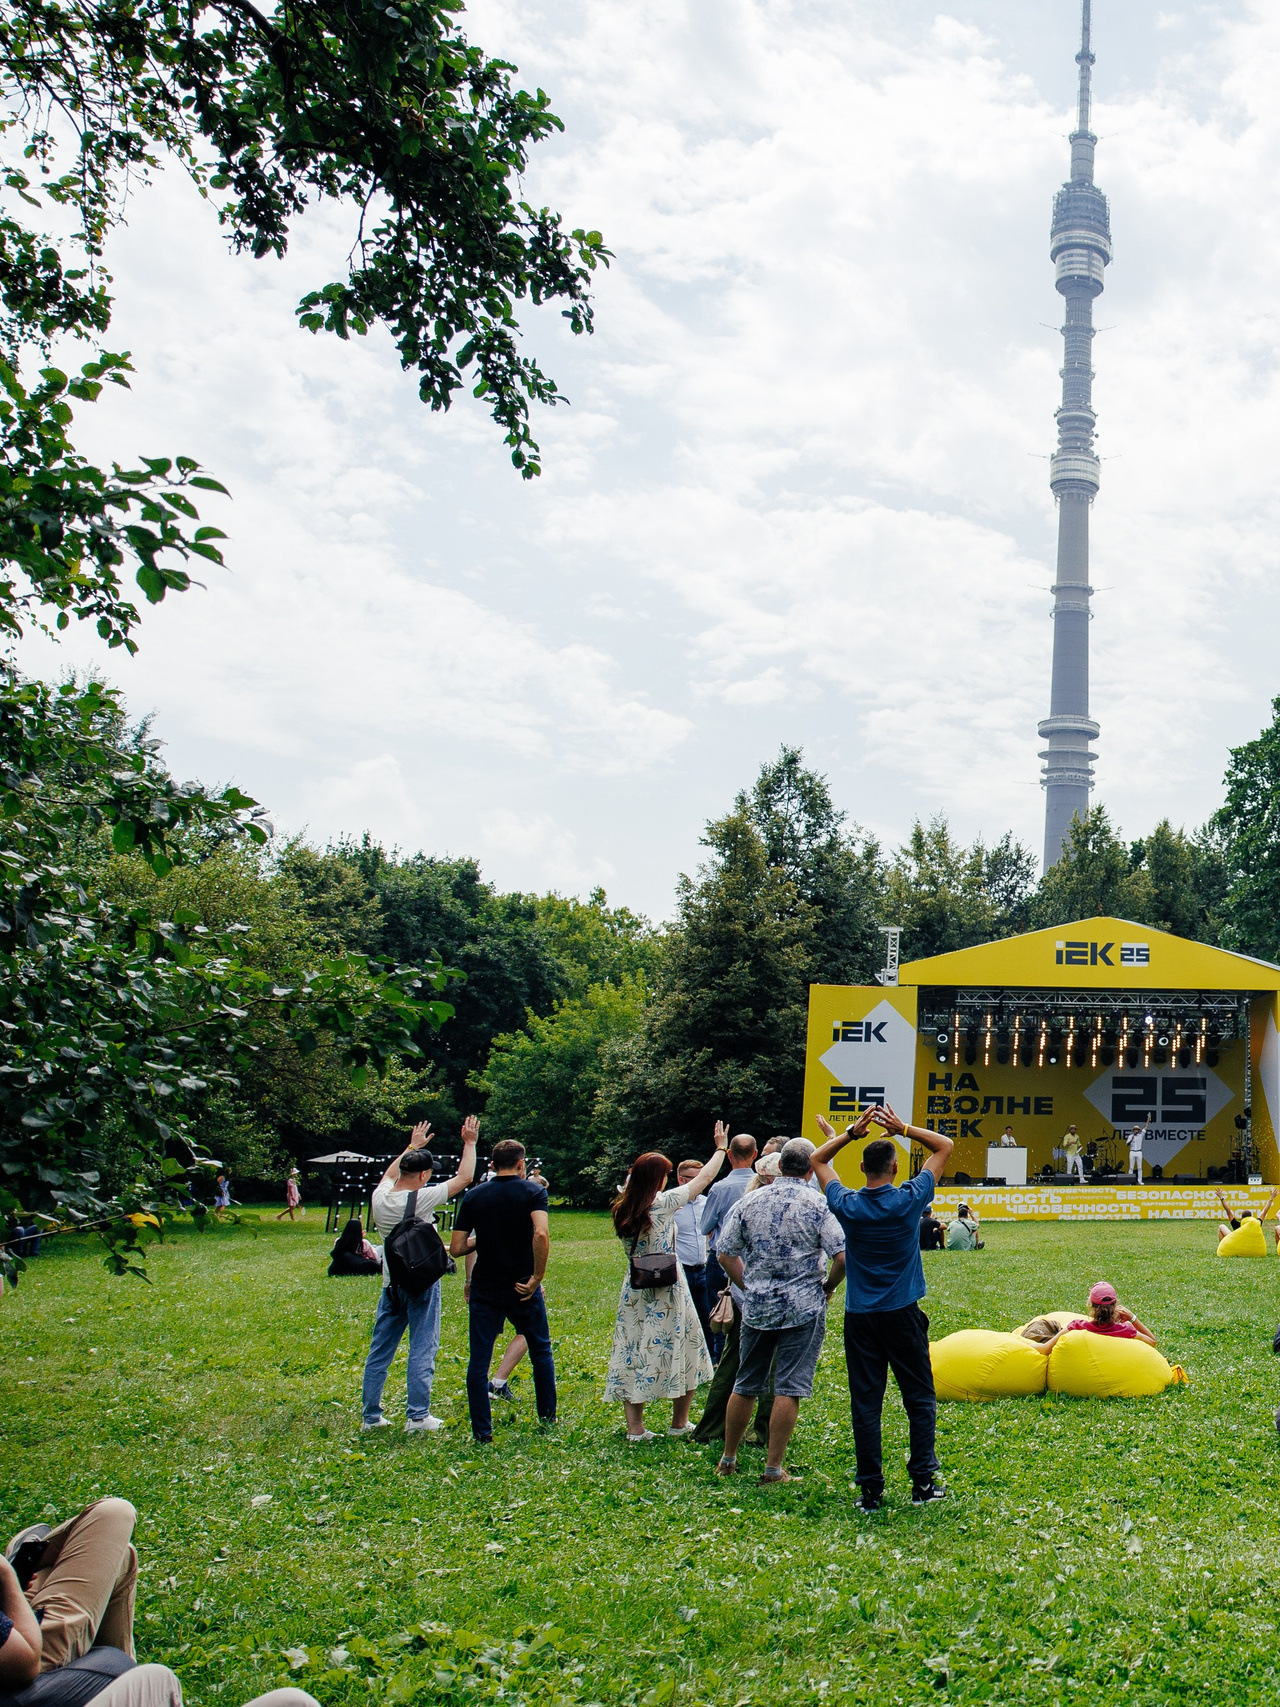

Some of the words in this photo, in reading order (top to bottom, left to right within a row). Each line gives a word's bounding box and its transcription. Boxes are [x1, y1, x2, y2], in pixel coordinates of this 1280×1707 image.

[1120, 948, 1150, 962] 25
[928, 1072, 980, 1091] НА
[829, 1086, 885, 1112] 25
[927, 1096, 1054, 1115] ВОЛНЕ
[1111, 1076, 1206, 1122] 25
[1145, 1129, 1206, 1140] ВМЕСТЕ
[931, 1193, 1062, 1204] ОСТУПНОСТЬ
[1116, 1190, 1249, 1200] БЕЗОПАСНОСТЬ
[1006, 1204, 1141, 1214] ЧЕЛОВЕЧНОСТЬ
